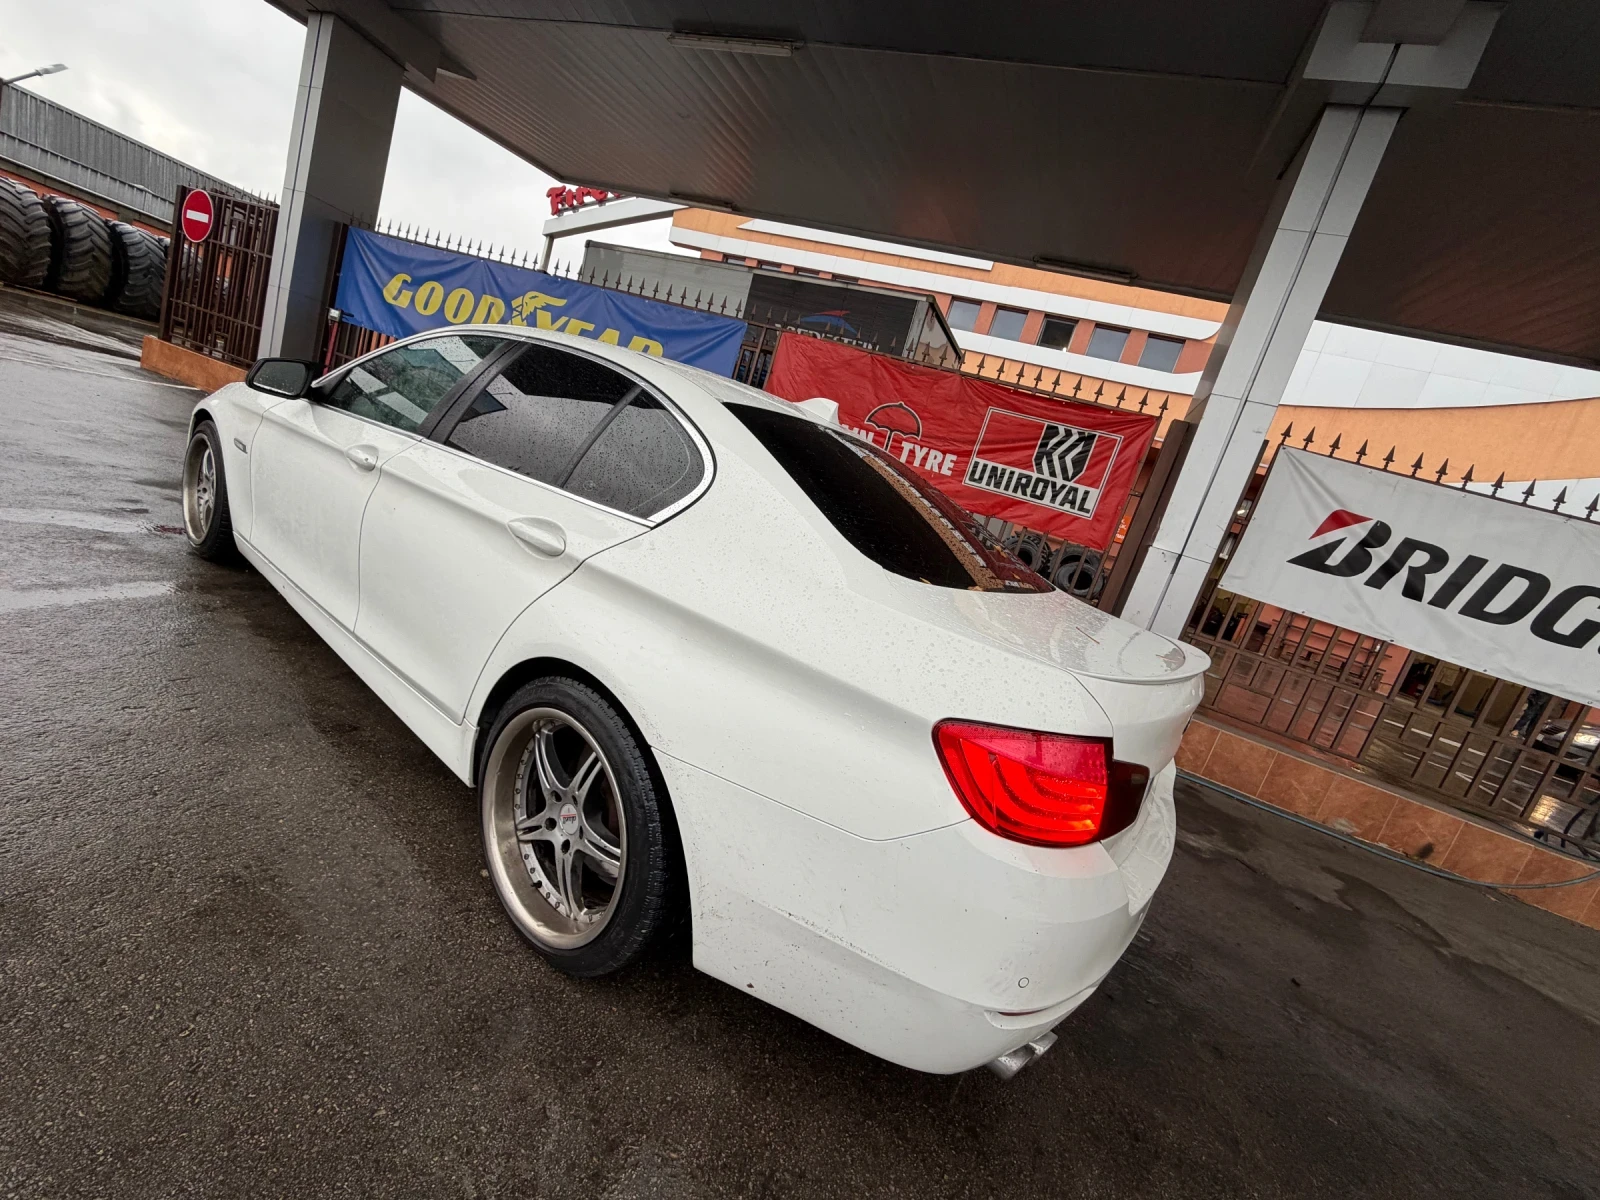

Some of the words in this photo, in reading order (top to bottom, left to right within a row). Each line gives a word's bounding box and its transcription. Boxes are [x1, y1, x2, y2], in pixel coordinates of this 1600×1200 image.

[899, 441, 958, 477] TYRE
[967, 460, 1092, 514] UNIROYAL
[1286, 509, 1600, 654] BRIDG
